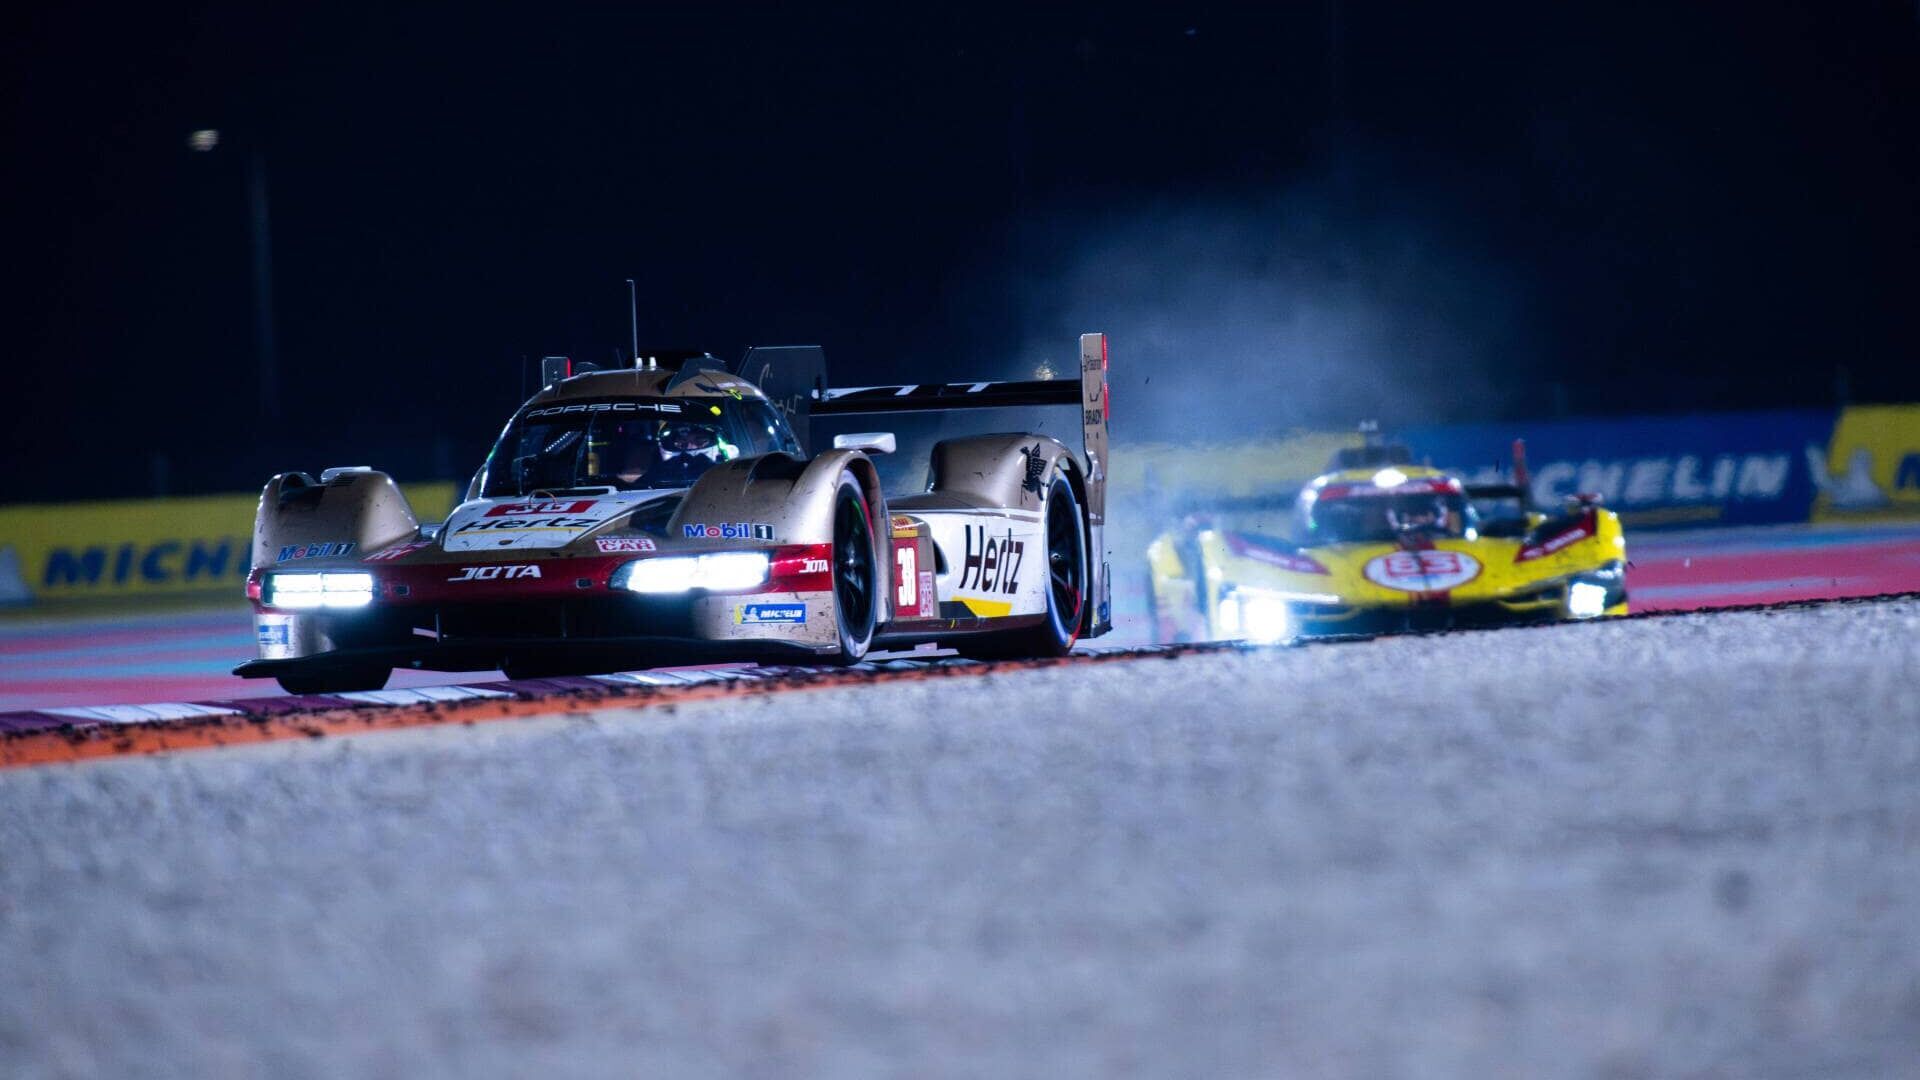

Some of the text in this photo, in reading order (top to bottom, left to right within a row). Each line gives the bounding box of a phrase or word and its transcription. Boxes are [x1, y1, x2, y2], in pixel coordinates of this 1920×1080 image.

[526, 402, 682, 419] PORSCHE
[1085, 409, 1103, 425] BRADY
[456, 516, 600, 533] Hertz
[683, 522, 750, 538] Mobil
[277, 542, 334, 562] Mobil
[601, 543, 654, 551] CAR
[44, 533, 252, 587] MICH
[799, 559, 828, 573] JOTA
[958, 524, 1025, 595] Hertz
[447, 564, 542, 582] JOTA
[896, 547, 917, 607] 38
[760, 609, 803, 619] MICHELIN
